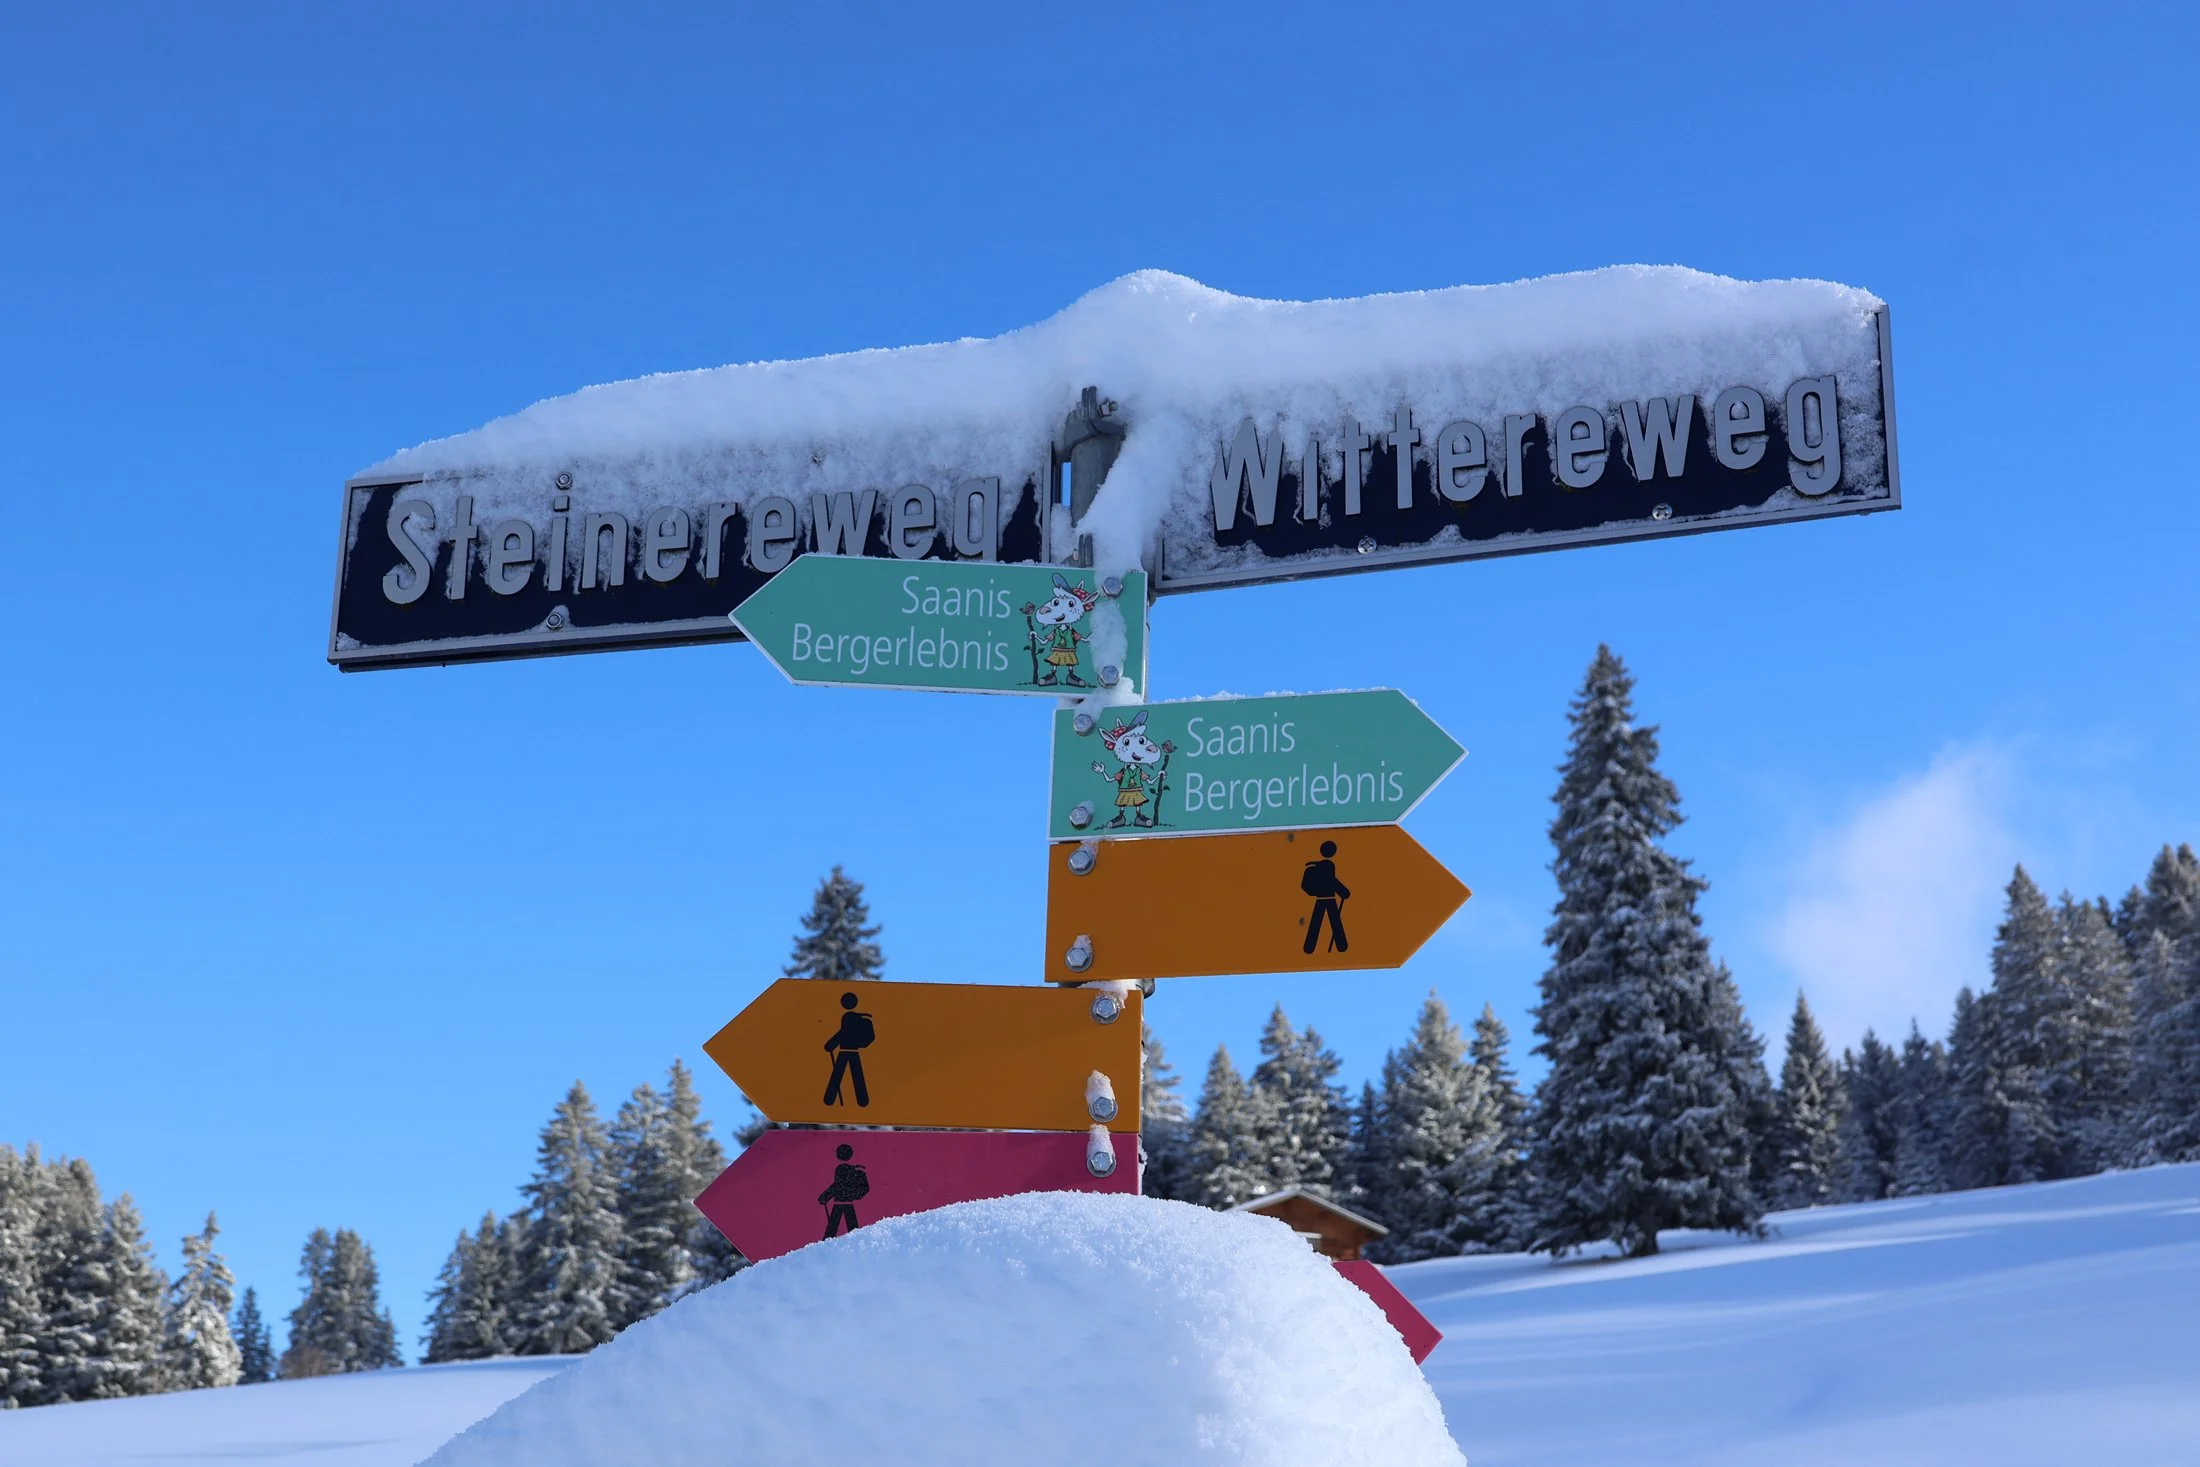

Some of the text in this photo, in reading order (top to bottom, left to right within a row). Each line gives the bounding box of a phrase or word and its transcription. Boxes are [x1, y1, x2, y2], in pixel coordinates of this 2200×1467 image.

[1211, 375, 1843, 531] Wittereweg
[383, 477, 1000, 604] Steinereweg
[902, 576, 1011, 618] Saanis
[792, 622, 1009, 675] Bergerlebnis
[1186, 712, 1296, 758] Saanis
[1184, 761, 1404, 820] Bergerlebnis
